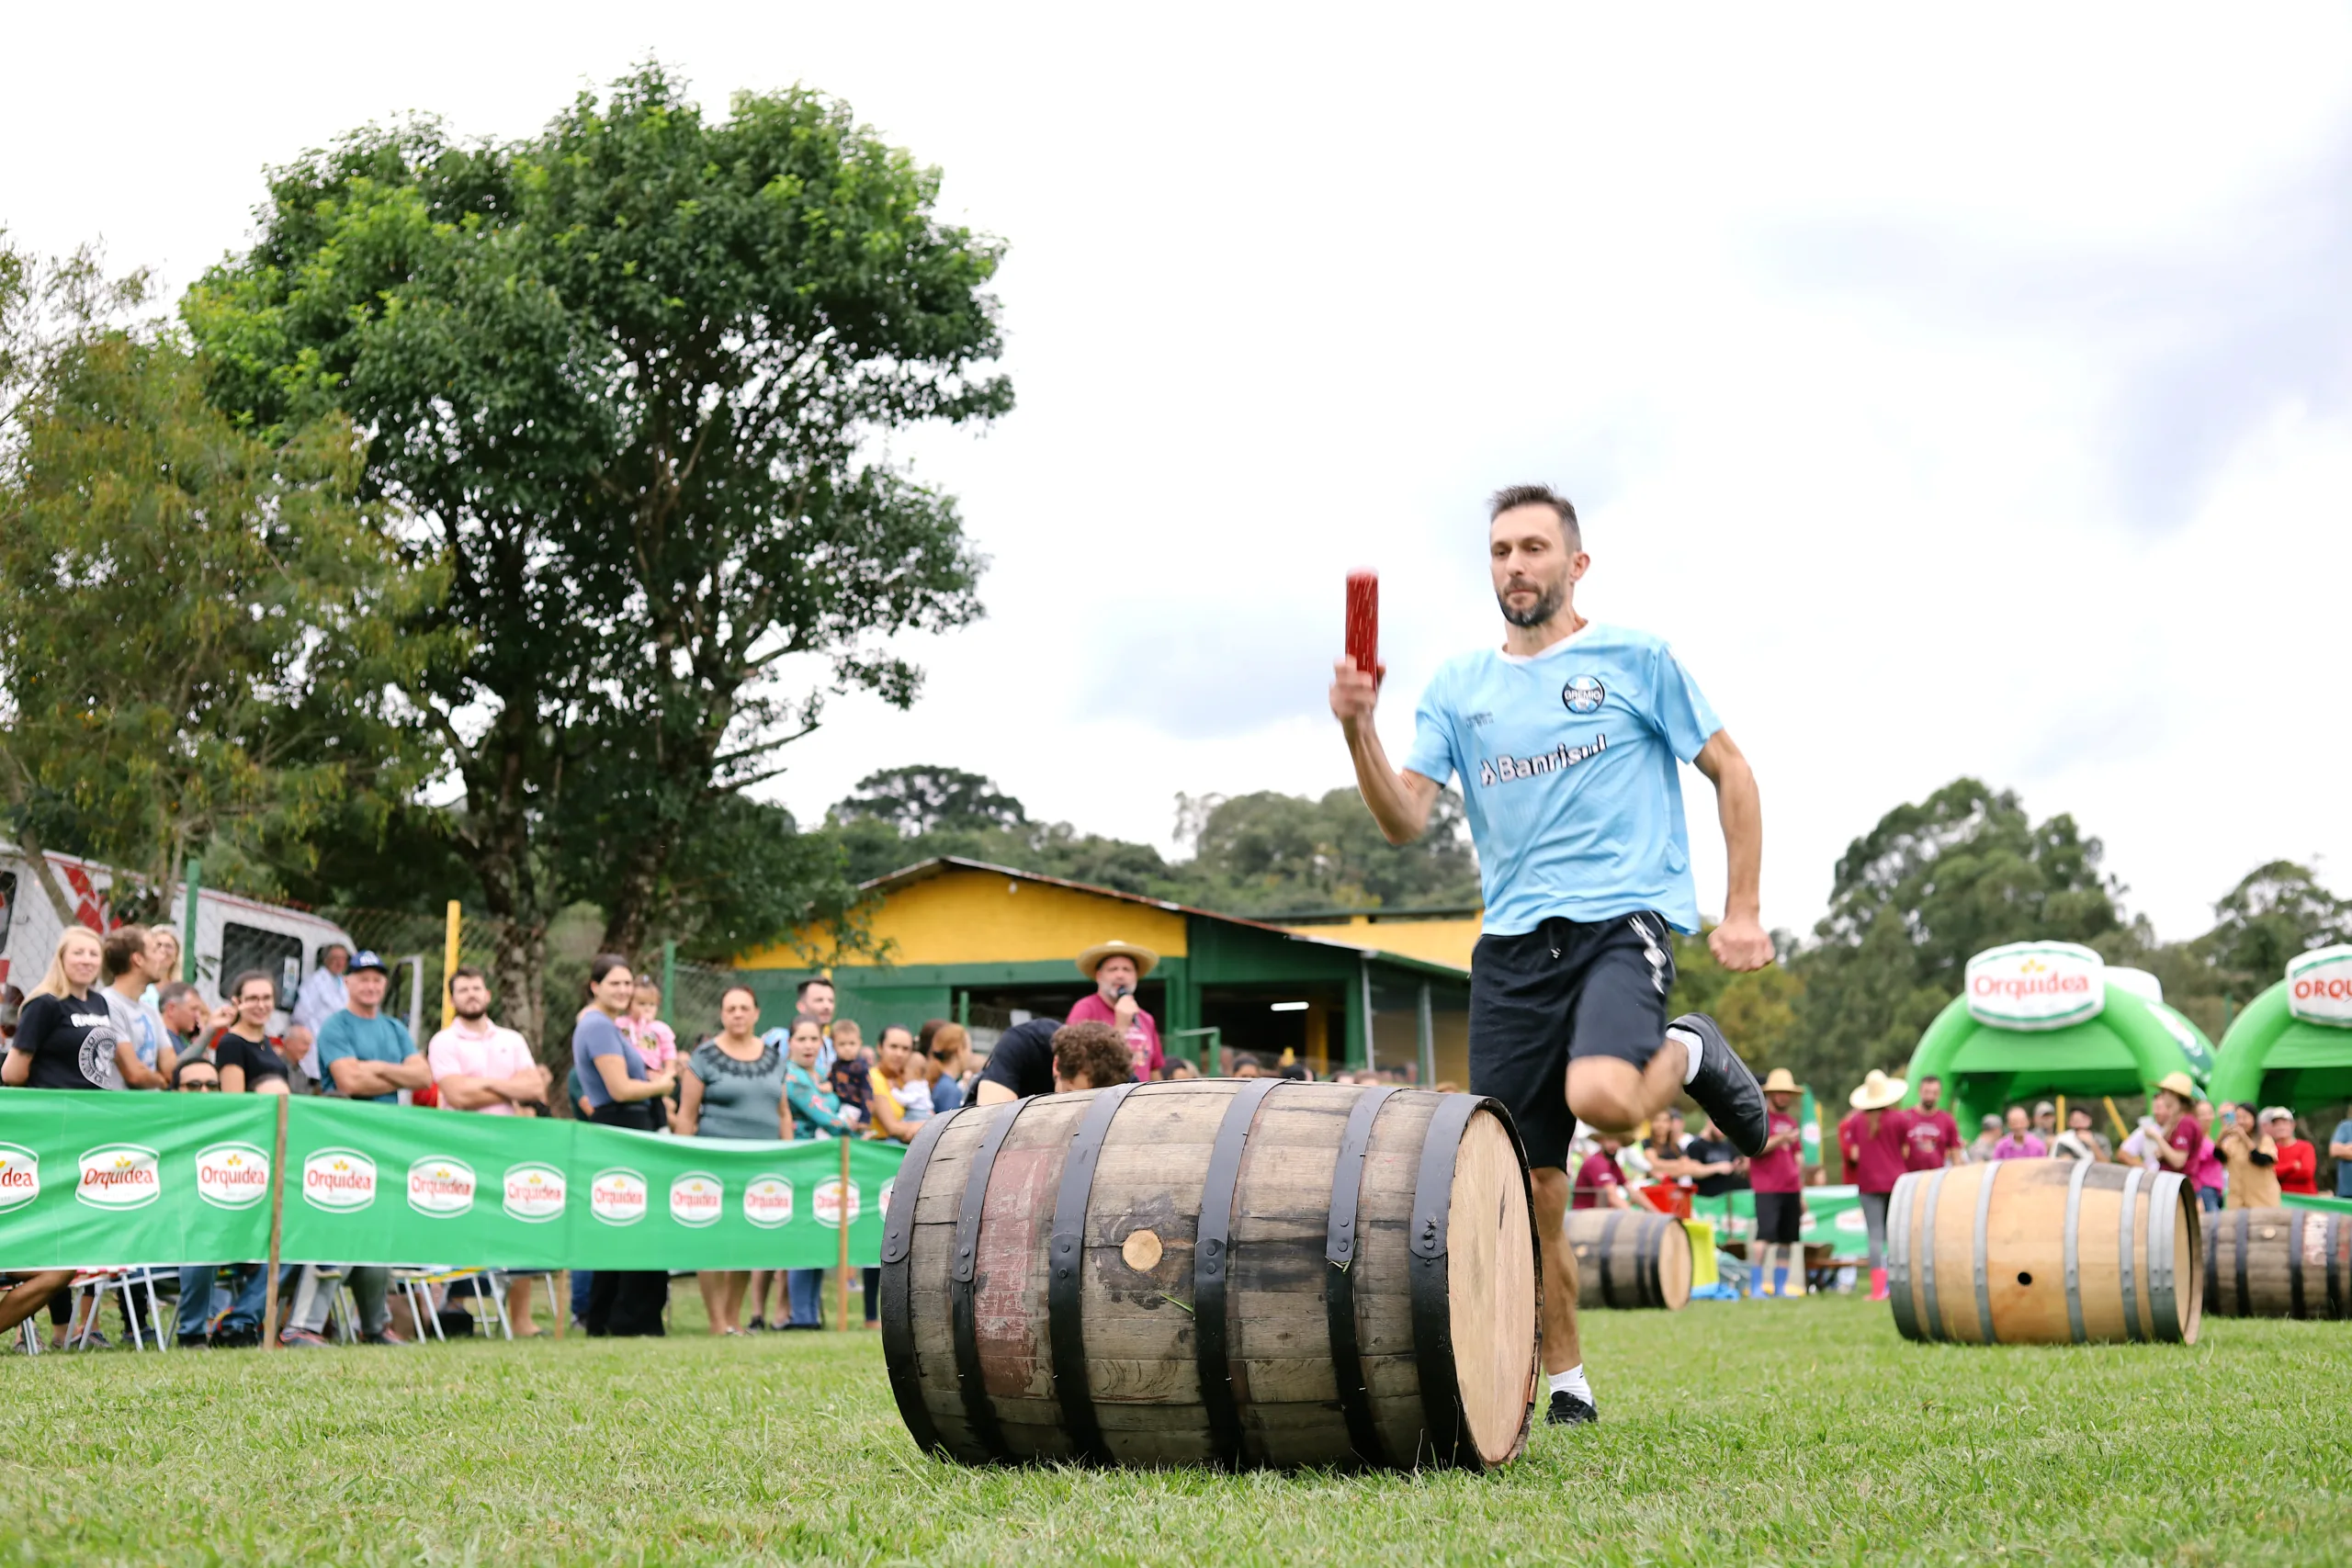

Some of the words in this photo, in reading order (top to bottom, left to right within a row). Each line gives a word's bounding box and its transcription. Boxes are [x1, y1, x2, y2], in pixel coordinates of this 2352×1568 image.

[1497, 733, 1607, 783] Banrisul
[83, 1163, 154, 1190] Orquidea
[200, 1164, 266, 1189] Orquidea
[306, 1168, 372, 1191] Orquidea
